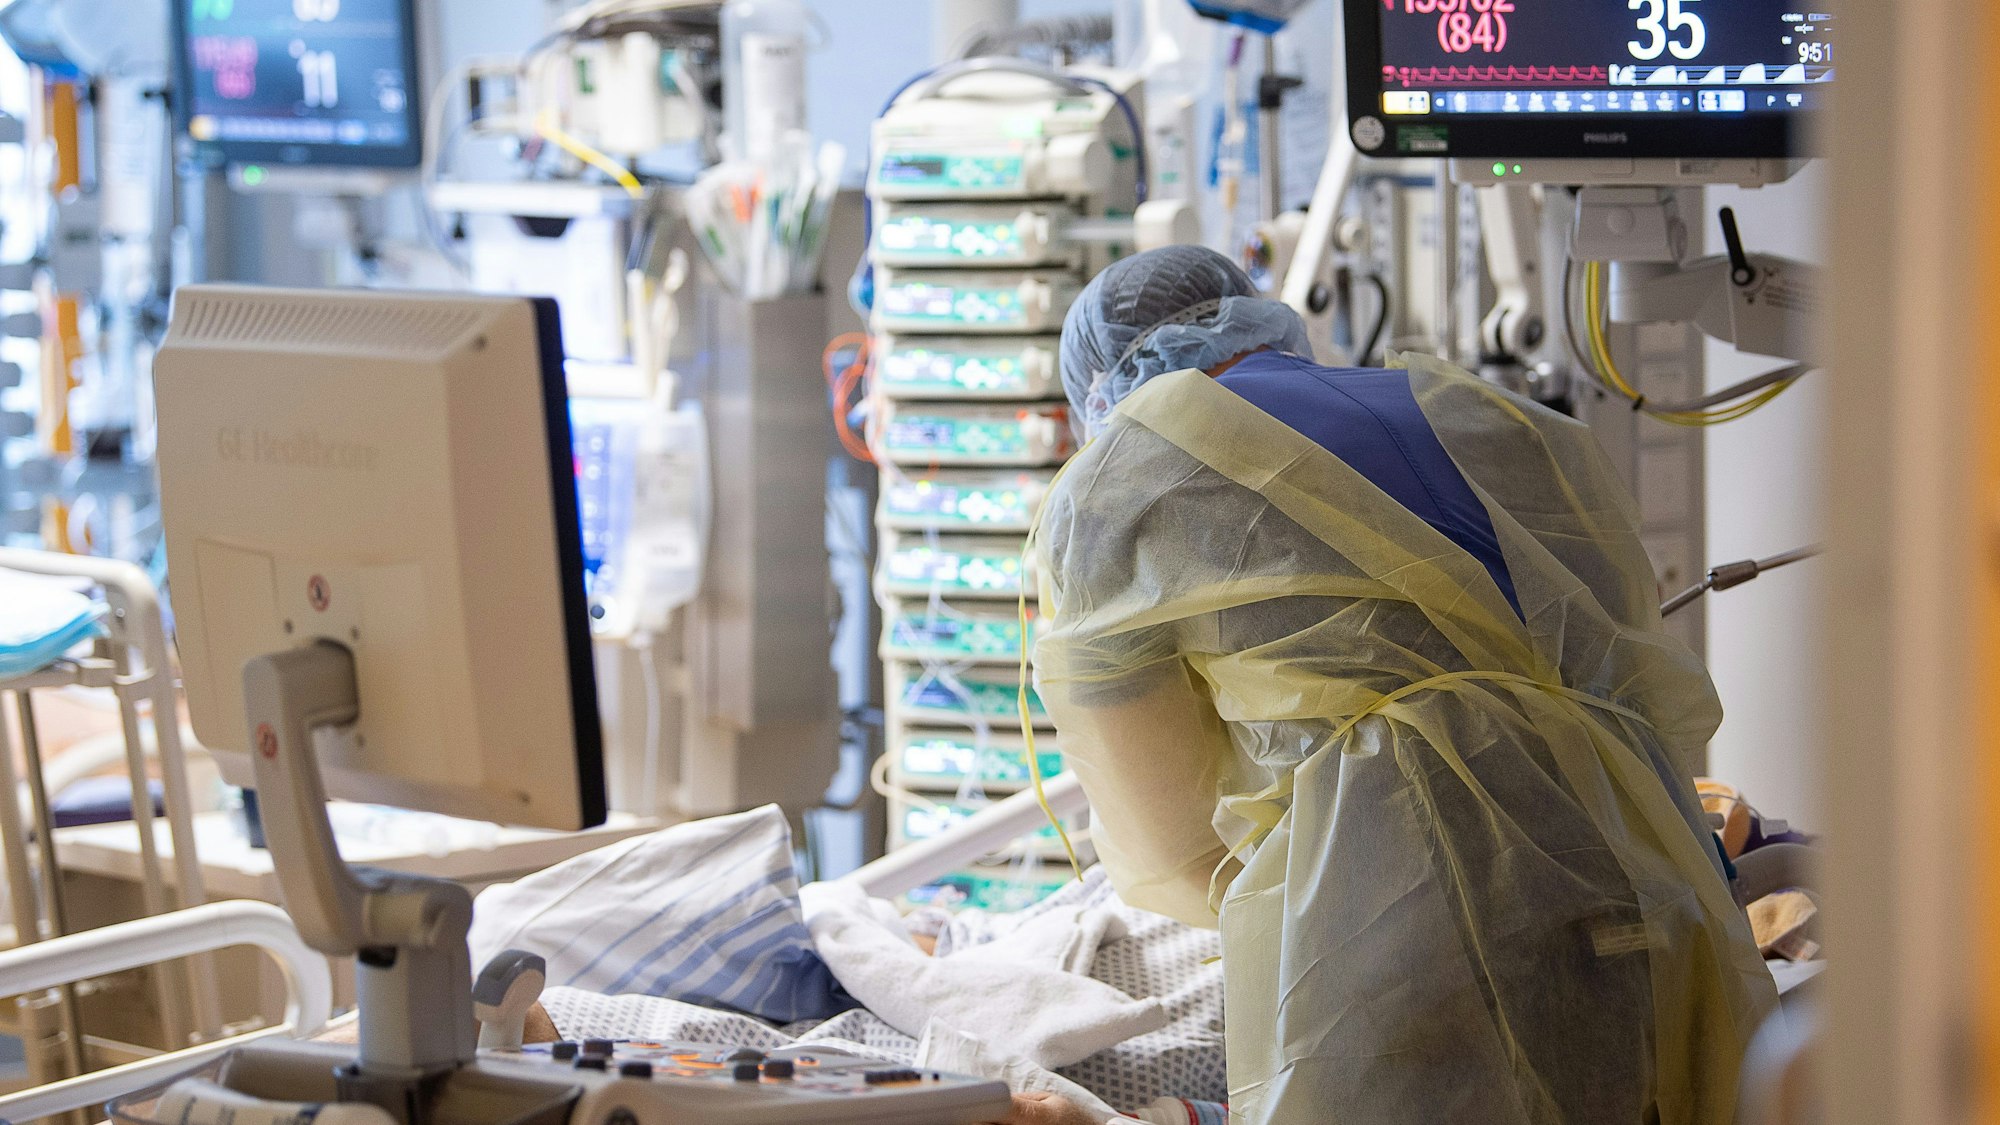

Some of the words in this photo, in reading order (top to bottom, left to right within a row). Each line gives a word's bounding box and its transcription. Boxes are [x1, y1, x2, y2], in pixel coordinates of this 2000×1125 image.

[1437, 12, 1507, 53] (84)
[1627, 0, 1706, 60] 35
[1798, 42, 1832, 63] 9:51
